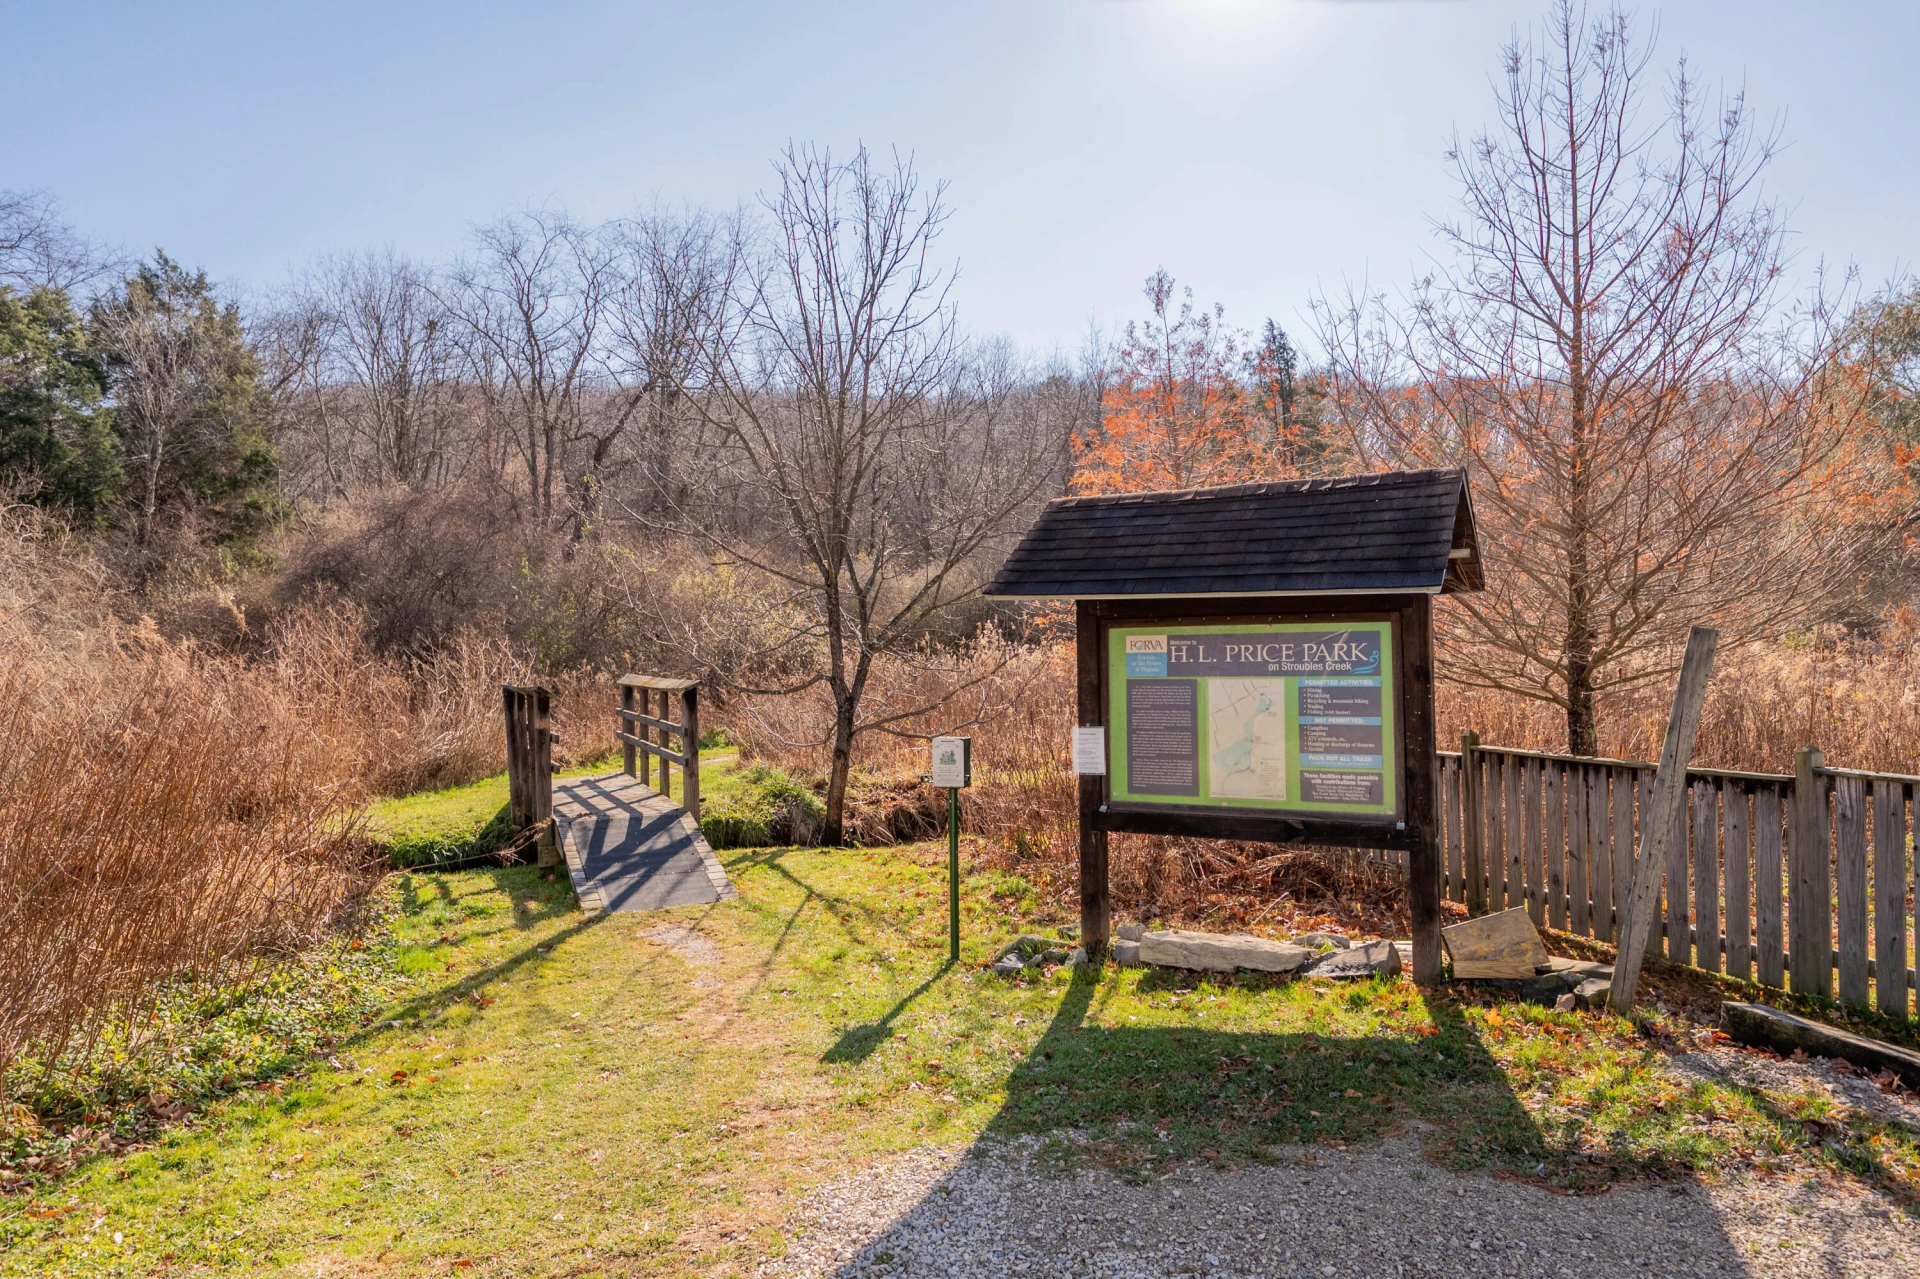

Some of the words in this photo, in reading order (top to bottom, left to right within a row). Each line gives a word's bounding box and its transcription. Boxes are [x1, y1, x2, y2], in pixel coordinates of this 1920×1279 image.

[1130, 640, 1163, 650] FORVA
[1170, 646, 1194, 663] H.
[1198, 645, 1217, 663] L.
[1224, 644, 1295, 662] PRICE
[1302, 642, 1369, 662] PARK
[1282, 662, 1323, 671] Stroubles
[1326, 662, 1352, 671] Creek
